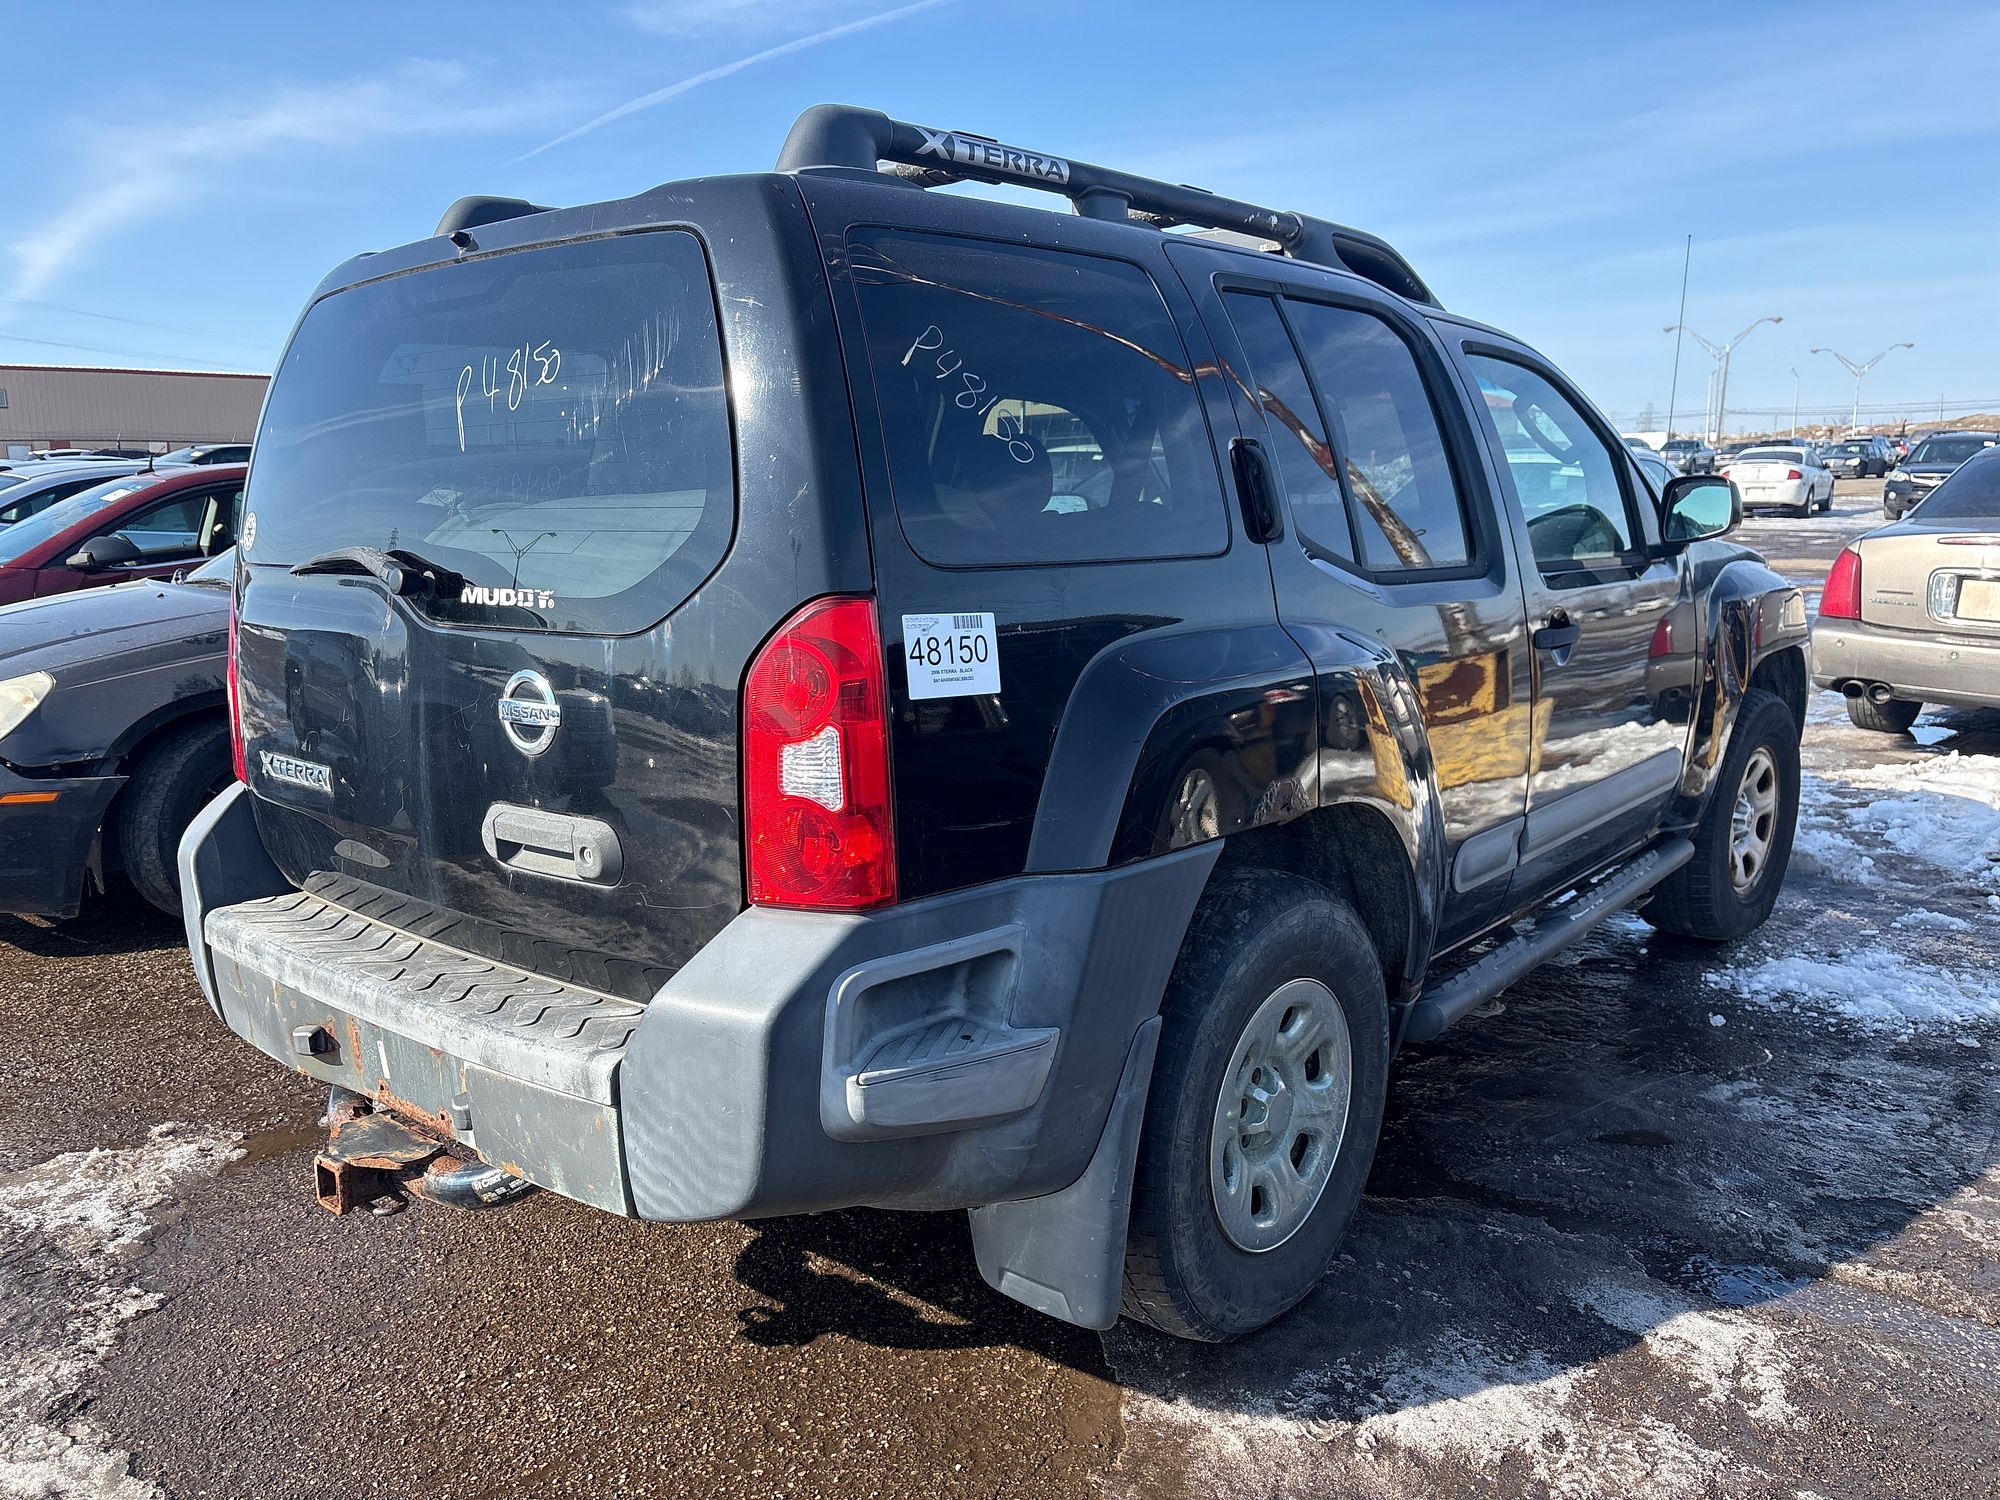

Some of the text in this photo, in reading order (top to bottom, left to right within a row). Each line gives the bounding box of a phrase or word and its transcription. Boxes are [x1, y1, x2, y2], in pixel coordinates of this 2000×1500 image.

[913, 126, 1067, 183] XTERRA
[909, 634, 988, 666] 48150
[501, 701, 550, 720] NISSAN
[259, 749, 331, 791] XTERRA
